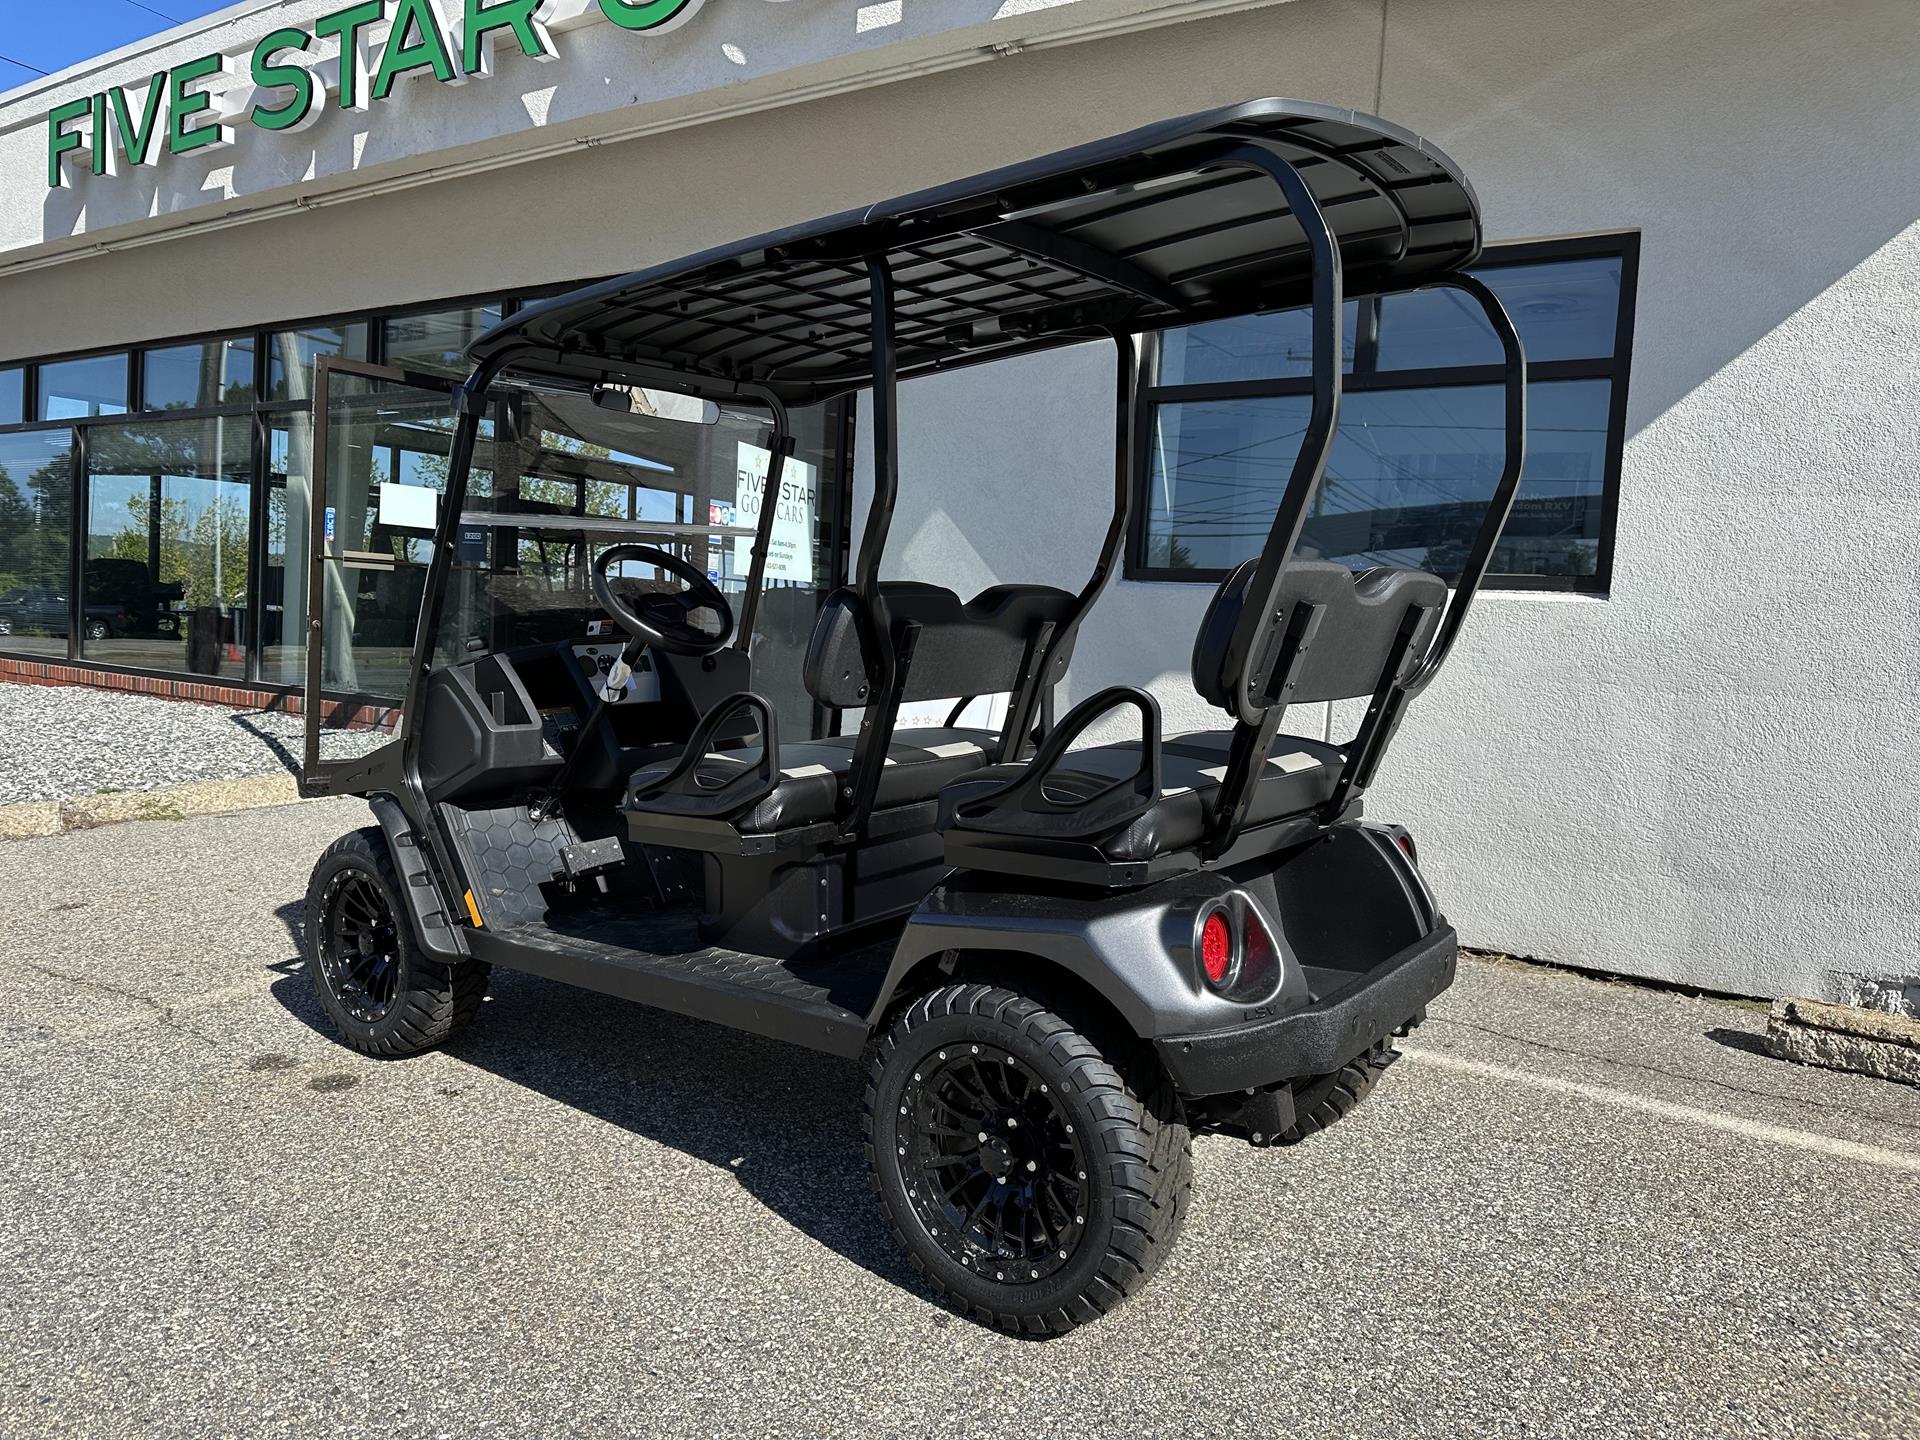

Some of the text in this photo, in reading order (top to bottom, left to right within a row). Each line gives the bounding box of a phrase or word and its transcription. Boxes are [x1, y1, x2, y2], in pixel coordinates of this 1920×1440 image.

[48, 0, 552, 187] FIVE STAR
[737, 469, 815, 507] FIVE STAR
[776, 502, 804, 524] CARS
[1545, 501, 1572, 511] RXV
[1244, 1004, 1276, 1021] LSV
